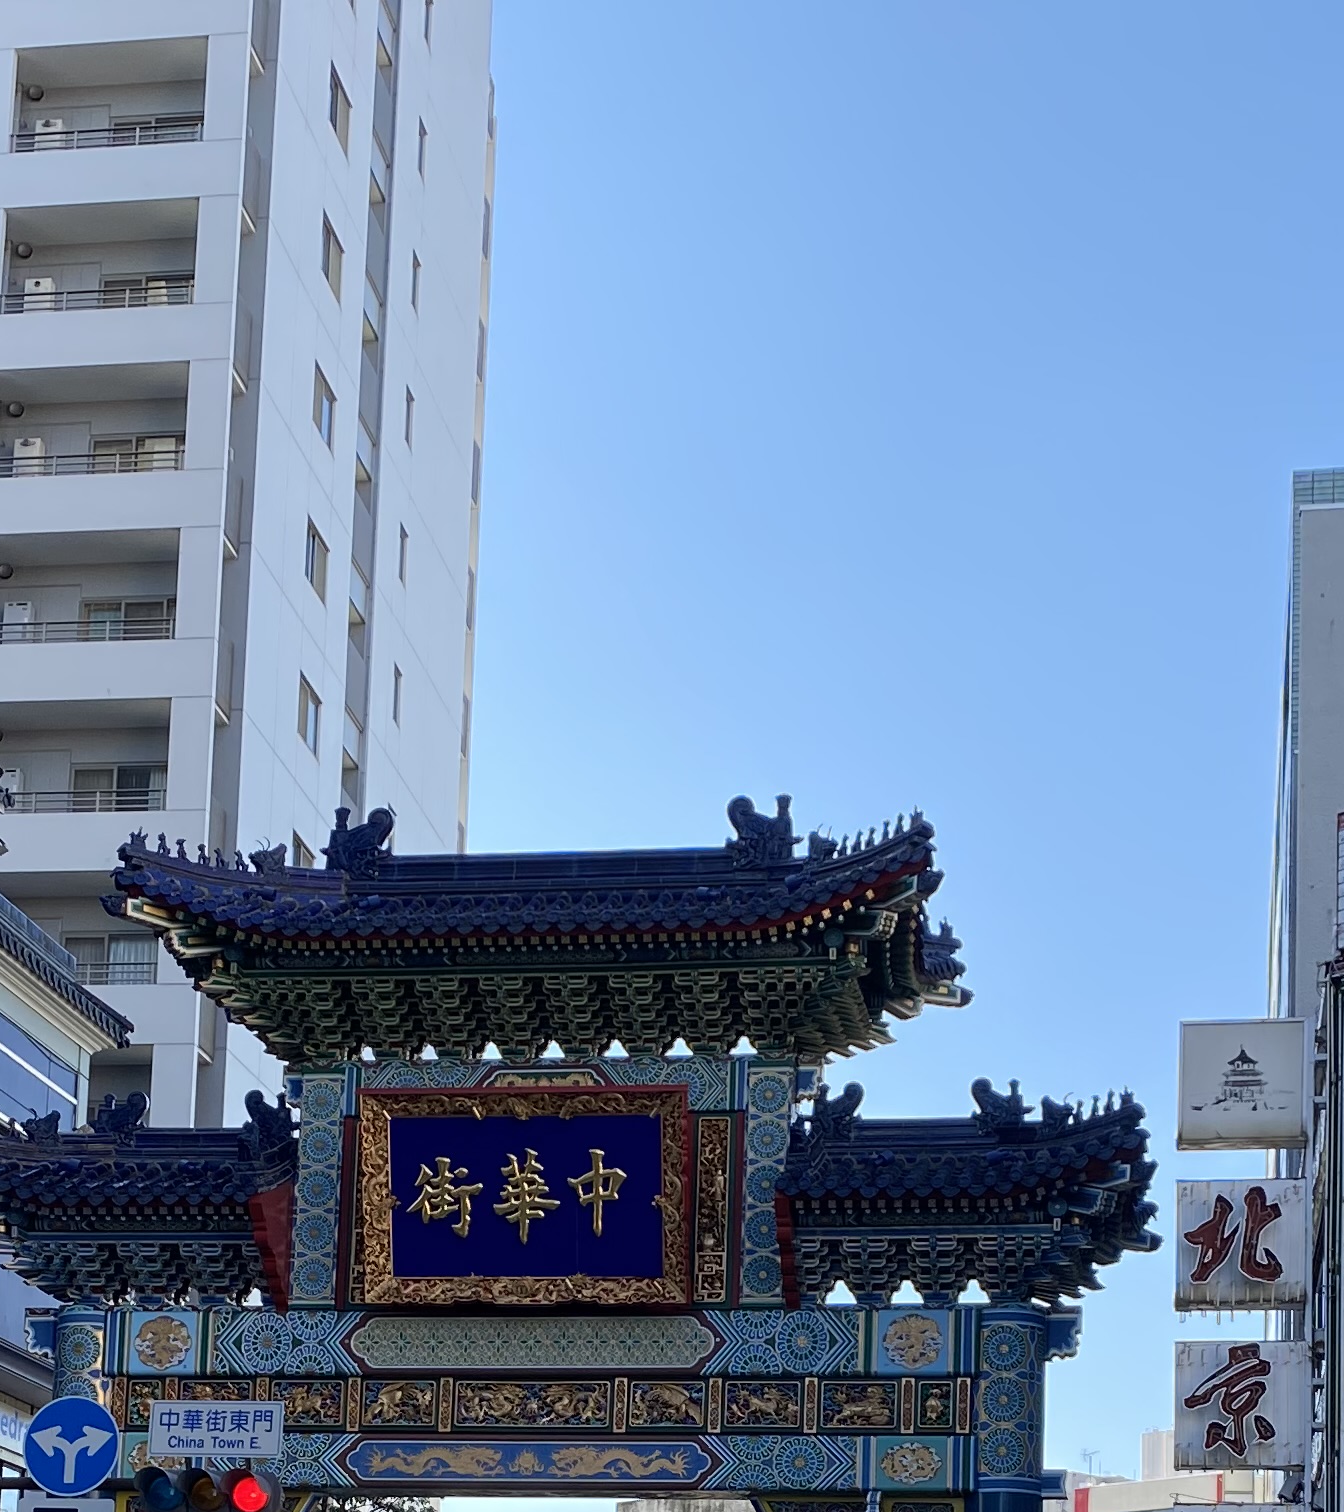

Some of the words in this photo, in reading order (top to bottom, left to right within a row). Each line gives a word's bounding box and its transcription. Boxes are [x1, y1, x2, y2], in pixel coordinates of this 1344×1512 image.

[158, 1408, 275, 1434] 中華街東門
[167, 1435, 205, 1449] China
[211, 1436, 247, 1449] Town
[250, 1436, 262, 1449] E.
